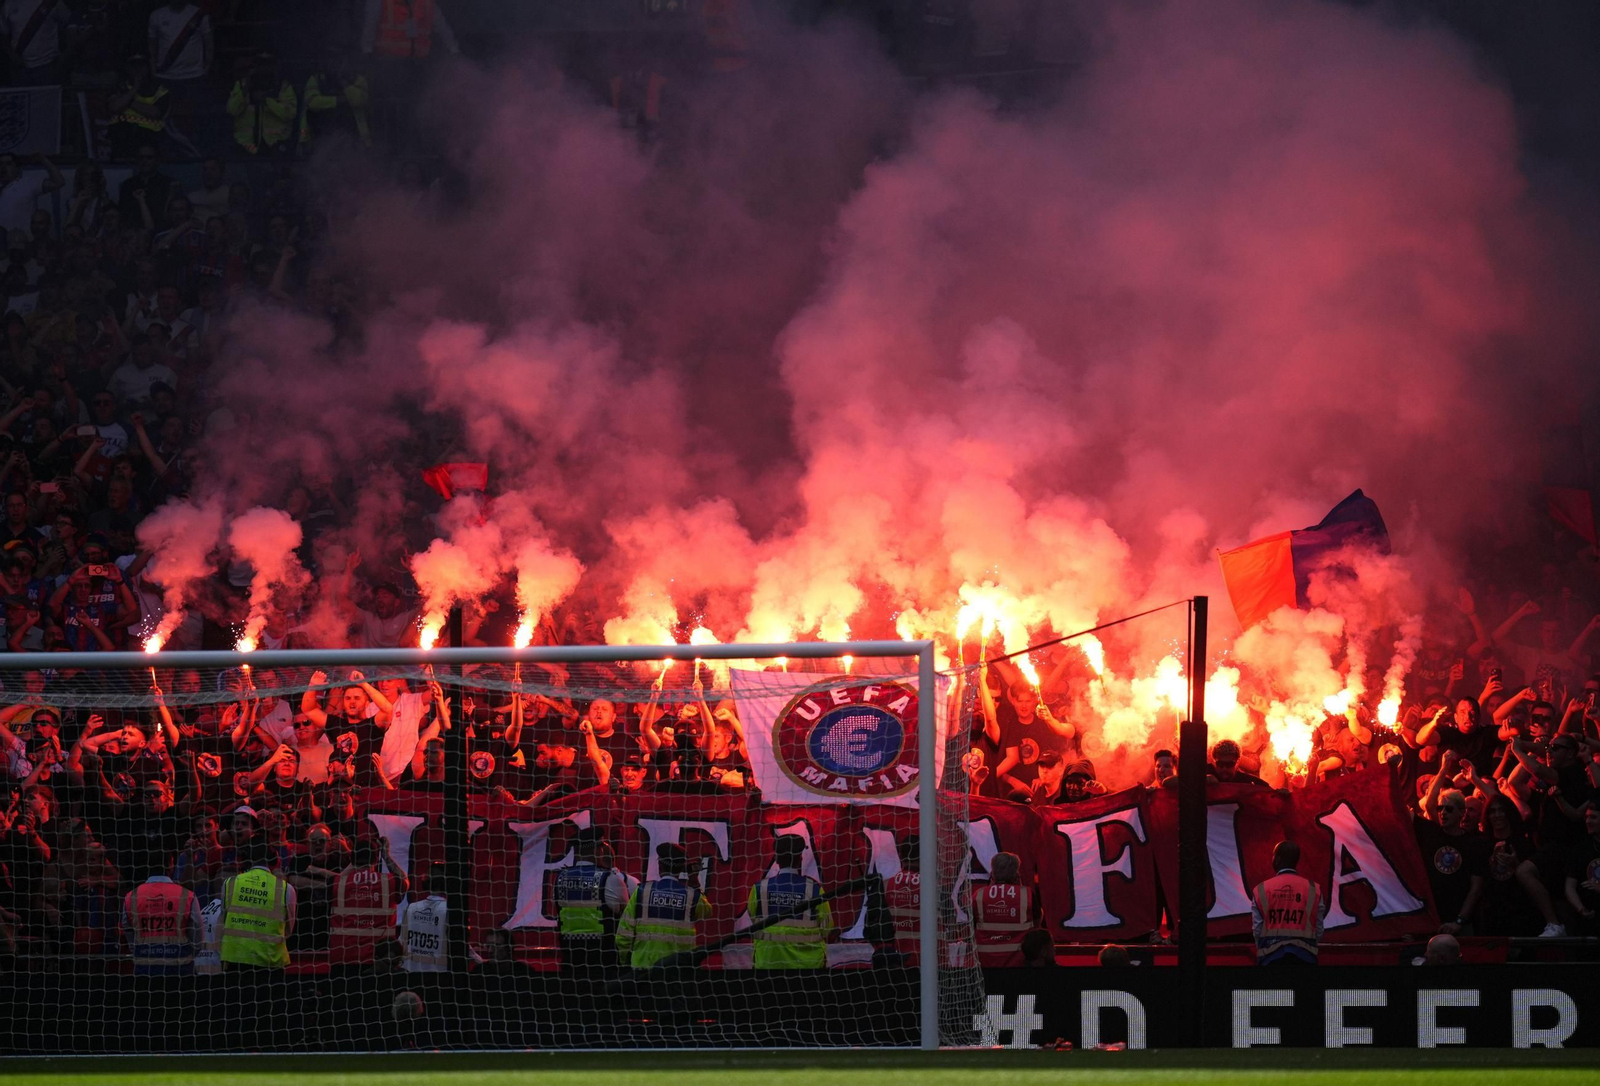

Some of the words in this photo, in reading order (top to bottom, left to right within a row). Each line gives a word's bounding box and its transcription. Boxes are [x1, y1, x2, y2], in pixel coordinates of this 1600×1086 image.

[795, 685, 911, 721] UEFA
[799, 763, 920, 792] MAFIA
[353, 869, 379, 885] 010
[893, 871, 921, 885] 018
[562, 880, 595, 890] POLICE
[988, 884, 1017, 899] 014
[239, 886, 269, 898] SENIOR
[237, 894, 269, 906] SAFETY
[652, 896, 684, 908] POLICE
[769, 895, 801, 906] POLICE
[230, 916, 268, 927] SUPERVISOR
[1268, 908, 1305, 925] RT447
